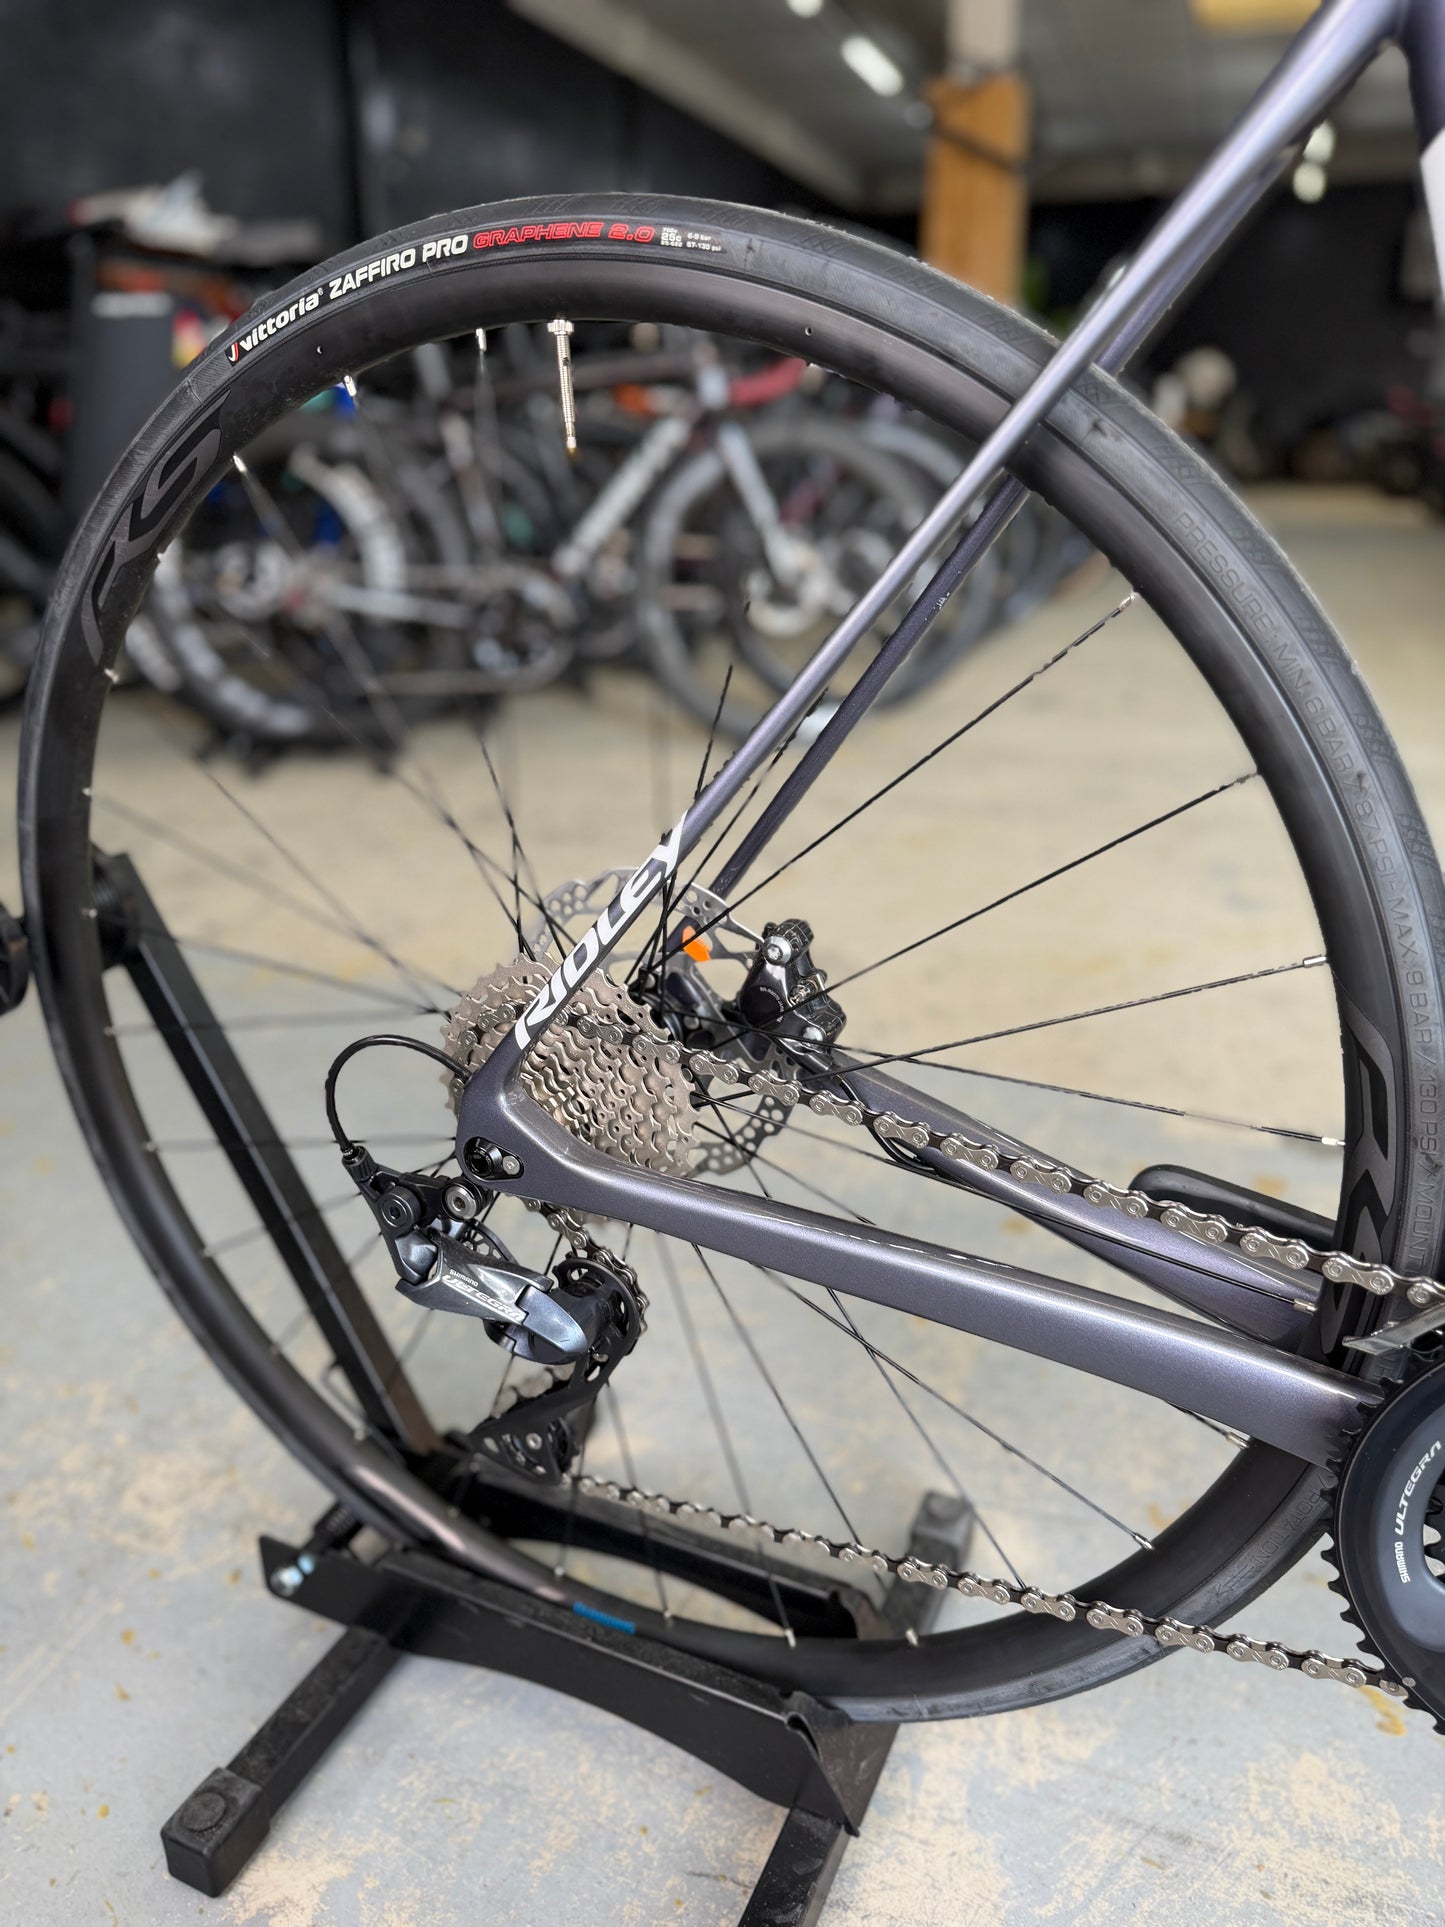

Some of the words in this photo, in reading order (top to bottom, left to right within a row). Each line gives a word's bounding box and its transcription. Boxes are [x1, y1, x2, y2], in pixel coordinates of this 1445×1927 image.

[661, 232, 682, 242] 25c
[329, 248, 416, 300] ZAFFIRO
[422, 234, 469, 262] PRO
[473, 222, 604, 249] GRAPHENE
[607, 223, 655, 242] 2.0
[1174, 512, 1274, 633] PRESSURE
[1303, 694, 1325, 716] 6
[1315, 716, 1354, 773] BAR
[1353, 798, 1380, 834] 87
[1368, 837, 1396, 878] PSI
[514, 809, 687, 1050] RIDLEY
[1386, 895, 1420, 963] MAX.
[1404, 968, 1424, 986] 9
[1407, 991, 1433, 1044] BAR
[1417, 1073, 1438, 1114] 130
[1420, 1120, 1438, 1155] PSI
[1407, 1184, 1438, 1265] MOUNT
[442, 1275, 526, 1322] ULTEGRA
[449, 1269, 478, 1287] SHIMANO
[1395, 1440, 1442, 1536] ULTEGRA
[1394, 1541, 1411, 1583] SHIMANO
